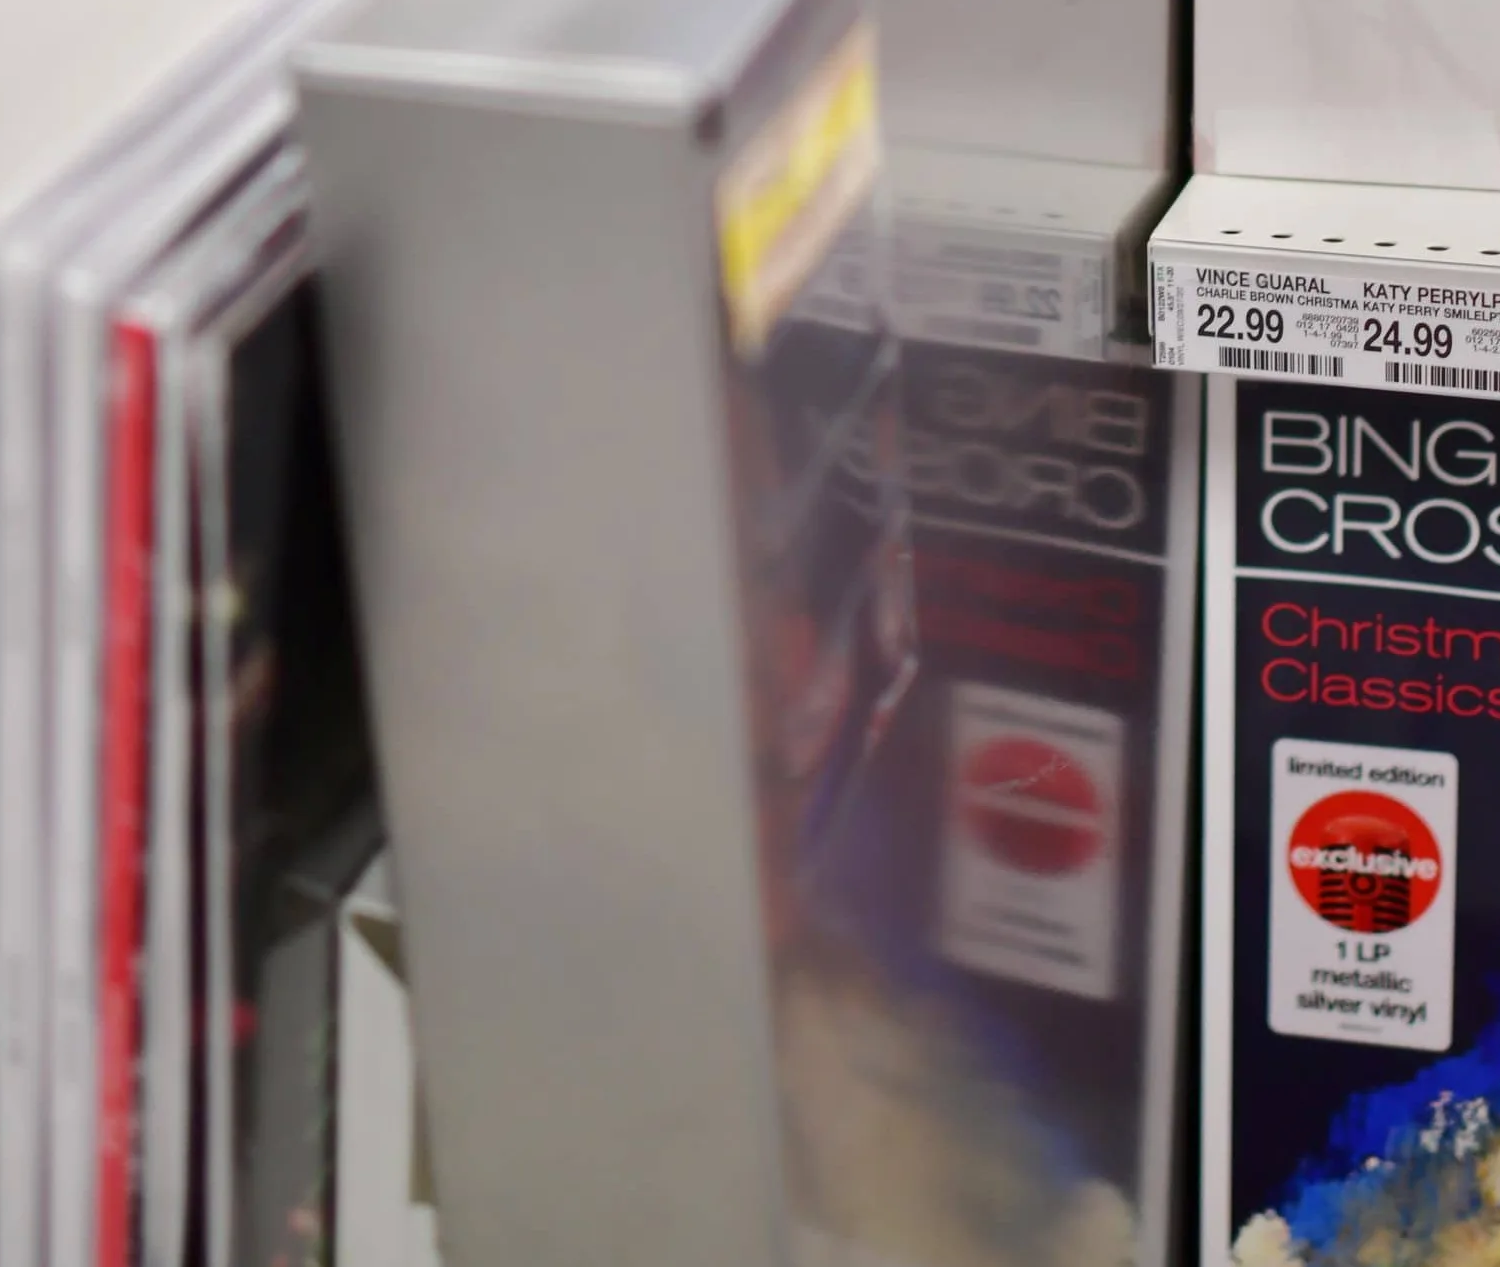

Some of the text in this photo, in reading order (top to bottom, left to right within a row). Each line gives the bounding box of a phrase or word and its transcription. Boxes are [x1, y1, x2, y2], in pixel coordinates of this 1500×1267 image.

[1196, 268, 1330, 294] VINCE GUARAL
[1363, 282, 1411, 301] KATY
[1196, 286, 1359, 310] CHARLIE BROWN CHRISTMA
[1363, 300, 1395, 314] KATY
[1399, 304, 1440, 318] PERRY
[1197, 303, 1284, 344] 22.99
[1363, 317, 1453, 359] 24.99
[1262, 411, 1497, 487] BING
[1287, 756, 1445, 788] limited edition
[1290, 843, 1439, 881] exclusive
[1336, 940, 1390, 963] 1 LP
[1311, 967, 1413, 993] metallic
[1296, 992, 1428, 1025] silver vinyl
